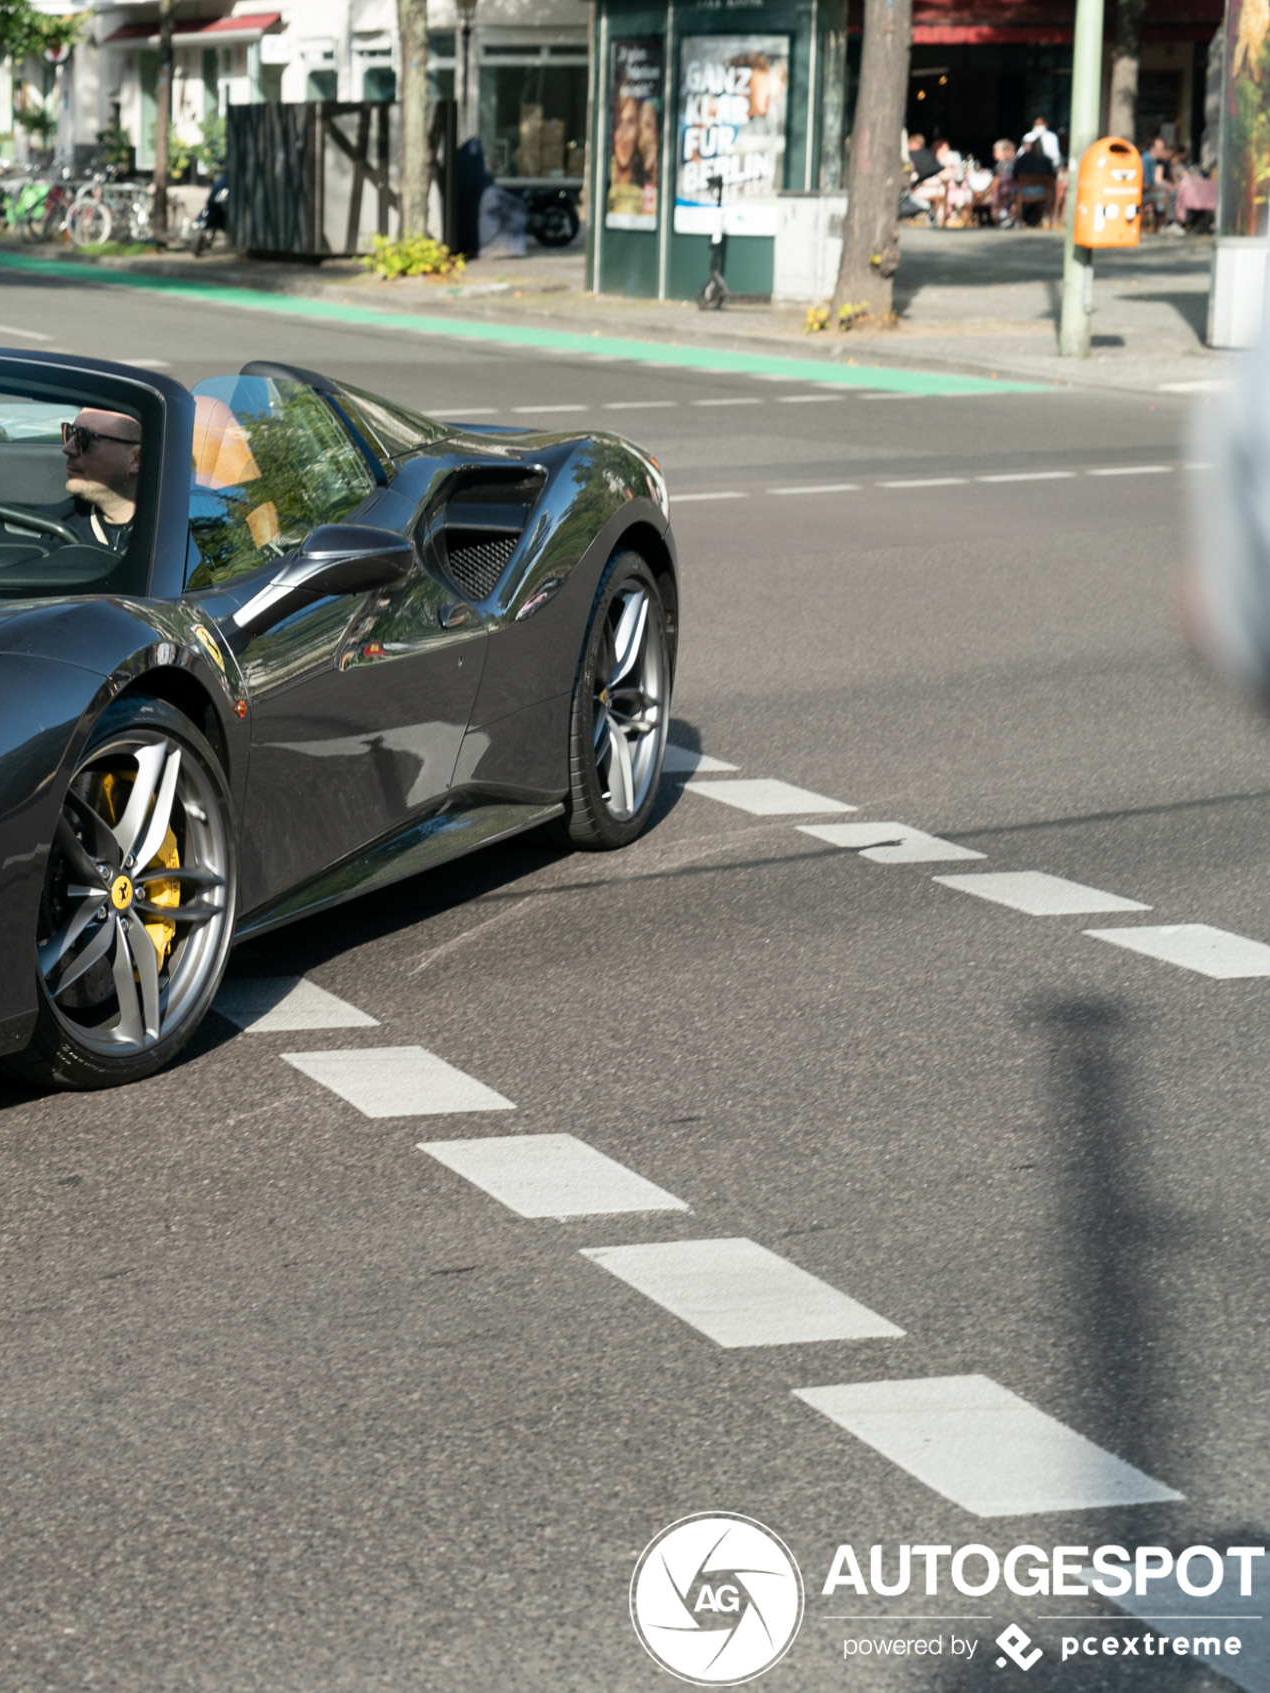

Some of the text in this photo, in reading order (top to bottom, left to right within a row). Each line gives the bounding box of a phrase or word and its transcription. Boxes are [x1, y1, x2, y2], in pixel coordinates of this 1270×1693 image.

[686, 60, 753, 94] GANZ
[685, 93, 750, 125] KLAR
[683, 152, 772, 193] BERLIN
